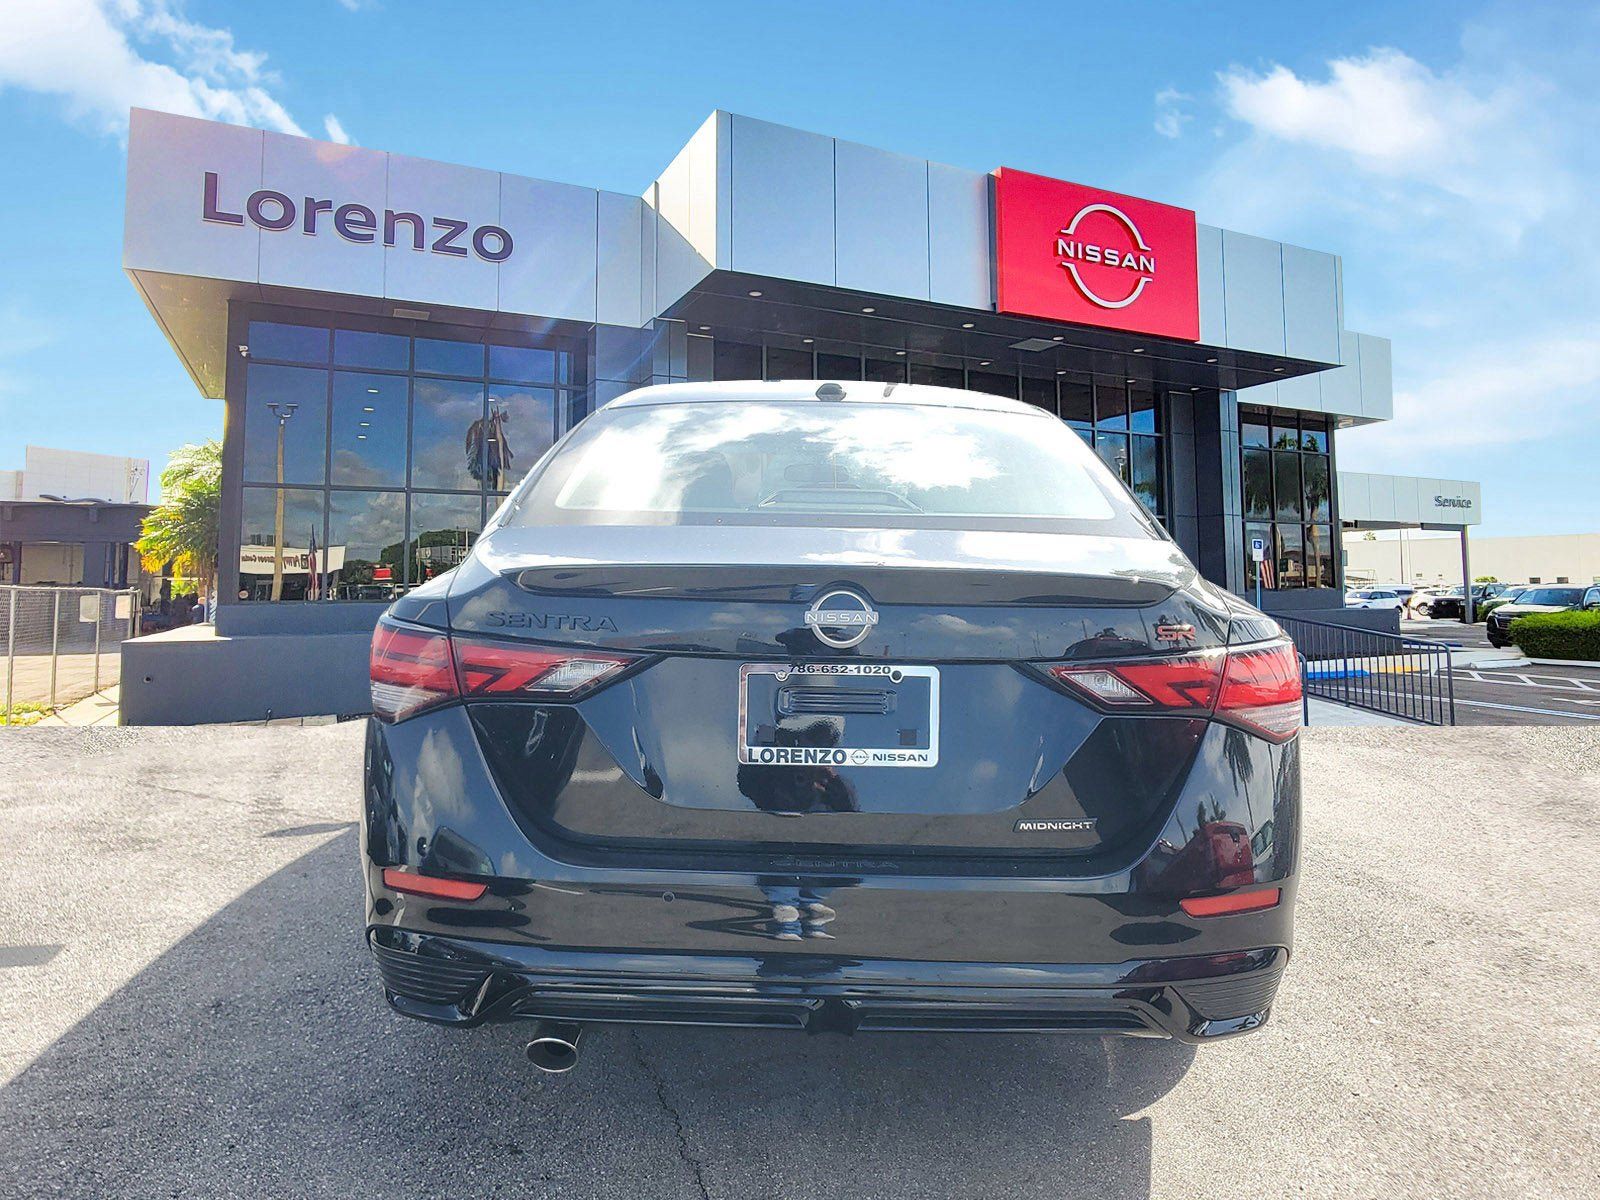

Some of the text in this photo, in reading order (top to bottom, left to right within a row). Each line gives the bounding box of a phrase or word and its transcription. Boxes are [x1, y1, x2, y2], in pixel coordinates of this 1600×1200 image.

[202, 170, 514, 262] Lorenzo
[1057, 238, 1155, 273] NISSAN
[1434, 495, 1472, 508] Service
[485, 610, 619, 632] SENTRA
[807, 613, 877, 623] NISSAN
[1157, 624, 1197, 641] SR
[788, 664, 891, 675] 786-652-1020
[748, 748, 847, 764] LORENZO
[872, 753, 928, 762] NISSAN
[1019, 821, 1093, 830] MIDNIGHT
